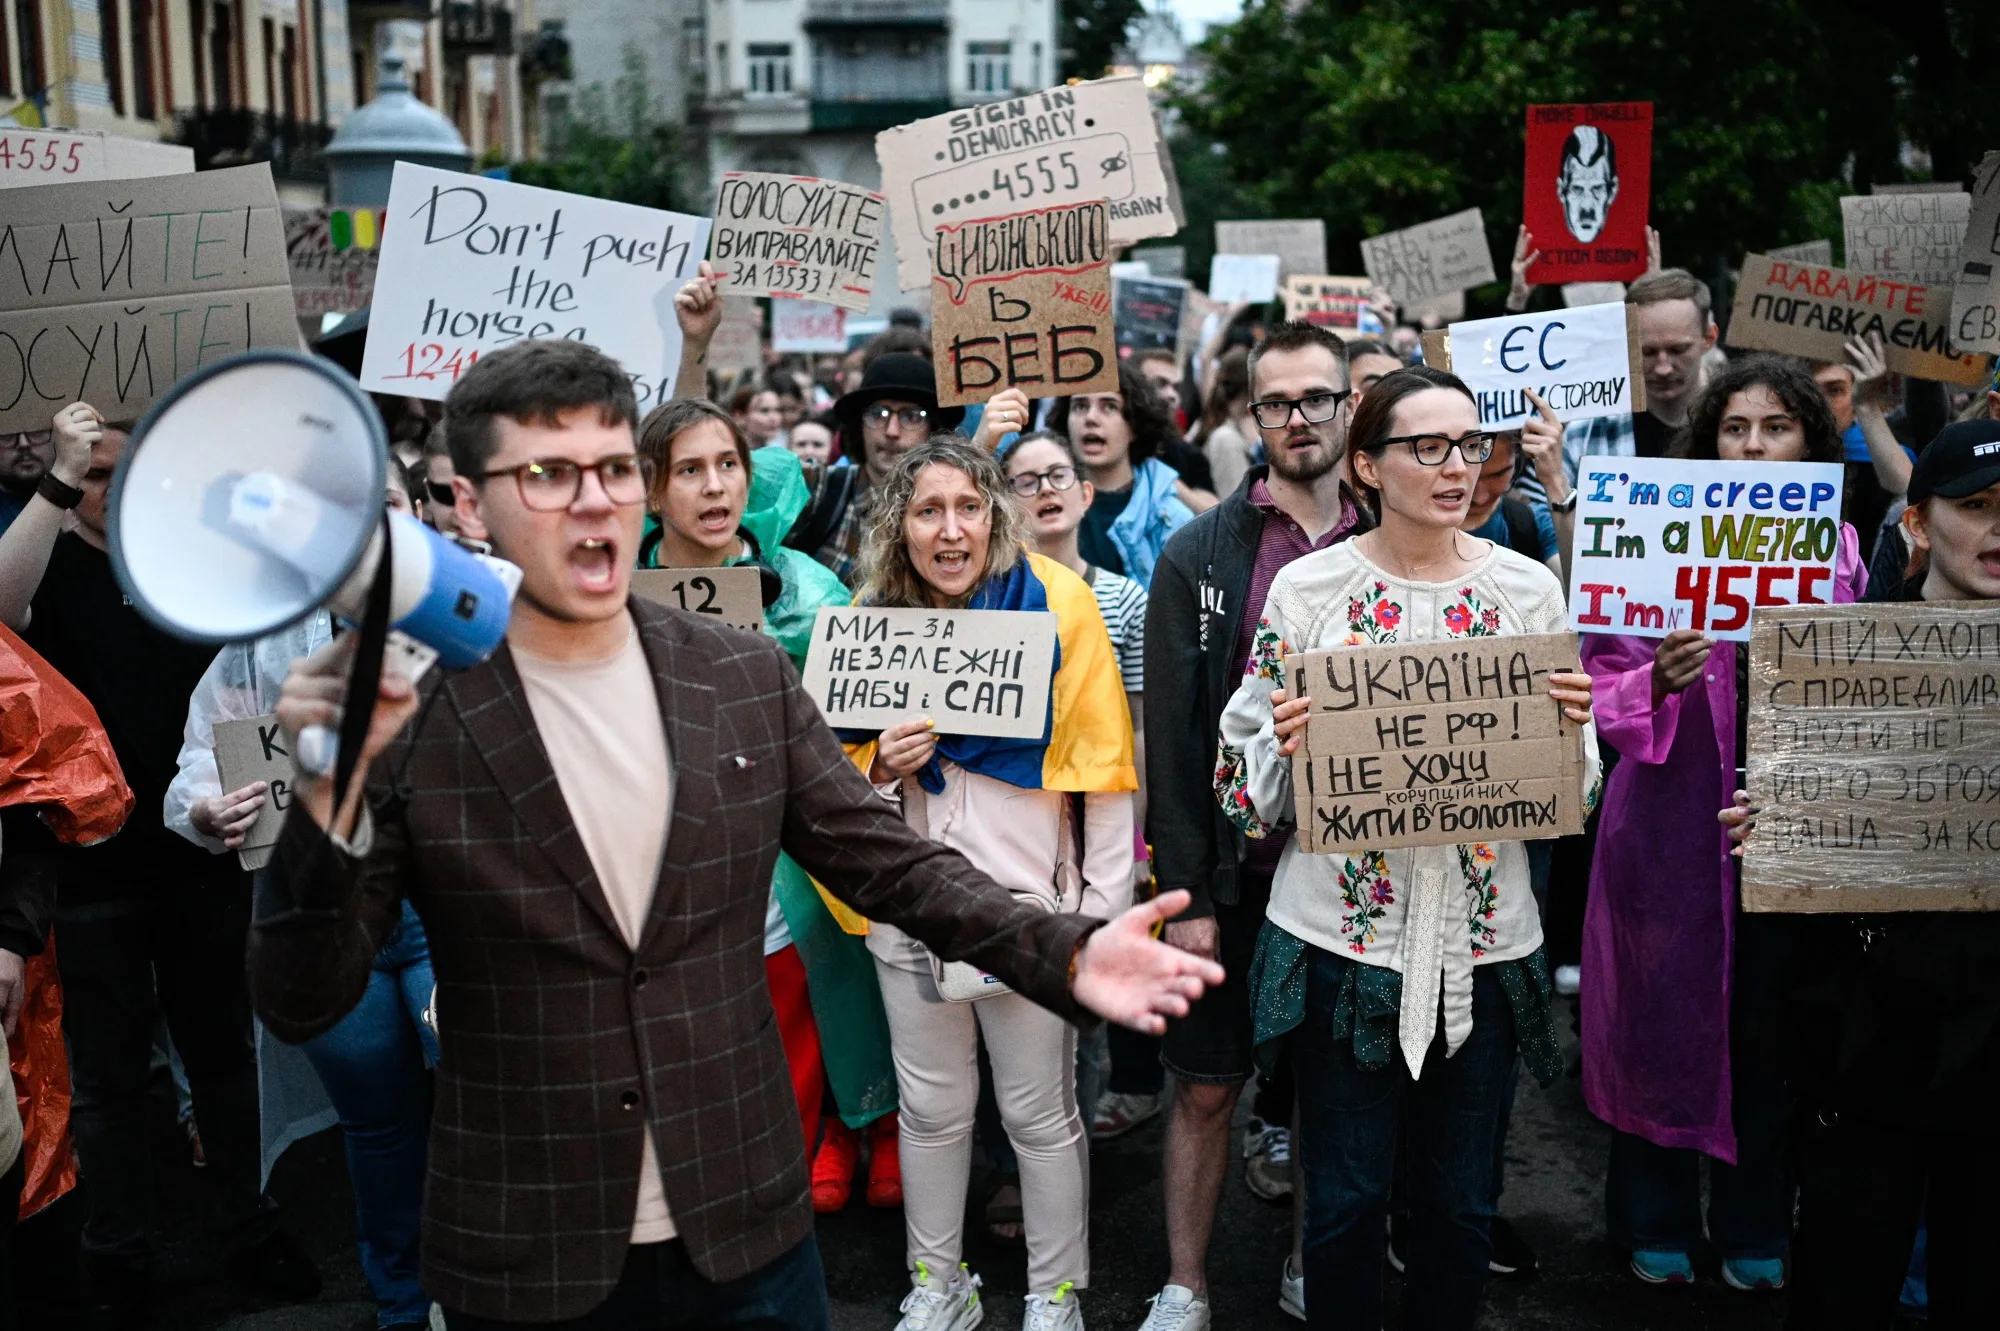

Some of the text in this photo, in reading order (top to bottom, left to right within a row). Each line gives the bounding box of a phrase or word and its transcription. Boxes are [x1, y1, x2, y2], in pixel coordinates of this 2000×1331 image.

[949, 89, 1075, 133] SIGN IN
[947, 109, 1077, 163] DEMOCRACY
[993, 151, 1079, 200] 4555
[1109, 195, 1163, 220] AGAIN
[409, 185, 692, 279] Don't push
[716, 228, 878, 279] ВИПРАВЛЯЙТЕ
[491, 265, 580, 313] the
[731, 261, 757, 286] ЗА
[1766, 262, 1929, 317] ДАВАЙТЕ
[948, 323, 1105, 394] БЕБ
[1500, 321, 1568, 374] ЄС
[1548, 376, 1626, 411] СТОРОНУ
[1586, 471, 1660, 506] I'm
[1667, 483, 1695, 509] a
[1580, 516, 1646, 560] I'm
[1661, 520, 1691, 555] a
[1577, 583, 1665, 630] I'm
[826, 615, 889, 643] МИ
[922, 617, 955, 640] ЗА
[1777, 616, 1878, 670] МІЙ
[828, 640, 1025, 681] НЕЗАЛЕЖНІ
[825, 677, 910, 714] НАБУ
[944, 679, 1024, 720] САП
[1376, 713, 1428, 750] НЕ
[1773, 713, 1965, 752] ПРОТИ НЕЇ
[1328, 754, 1383, 795] НЕ
[1385, 779, 1520, 807] КОРУПЦІЙНИХ
[1316, 804, 1407, 846] ЖИТИ
[1774, 814, 1880, 852] ВАША
[1913, 819, 1953, 851] ЗА
